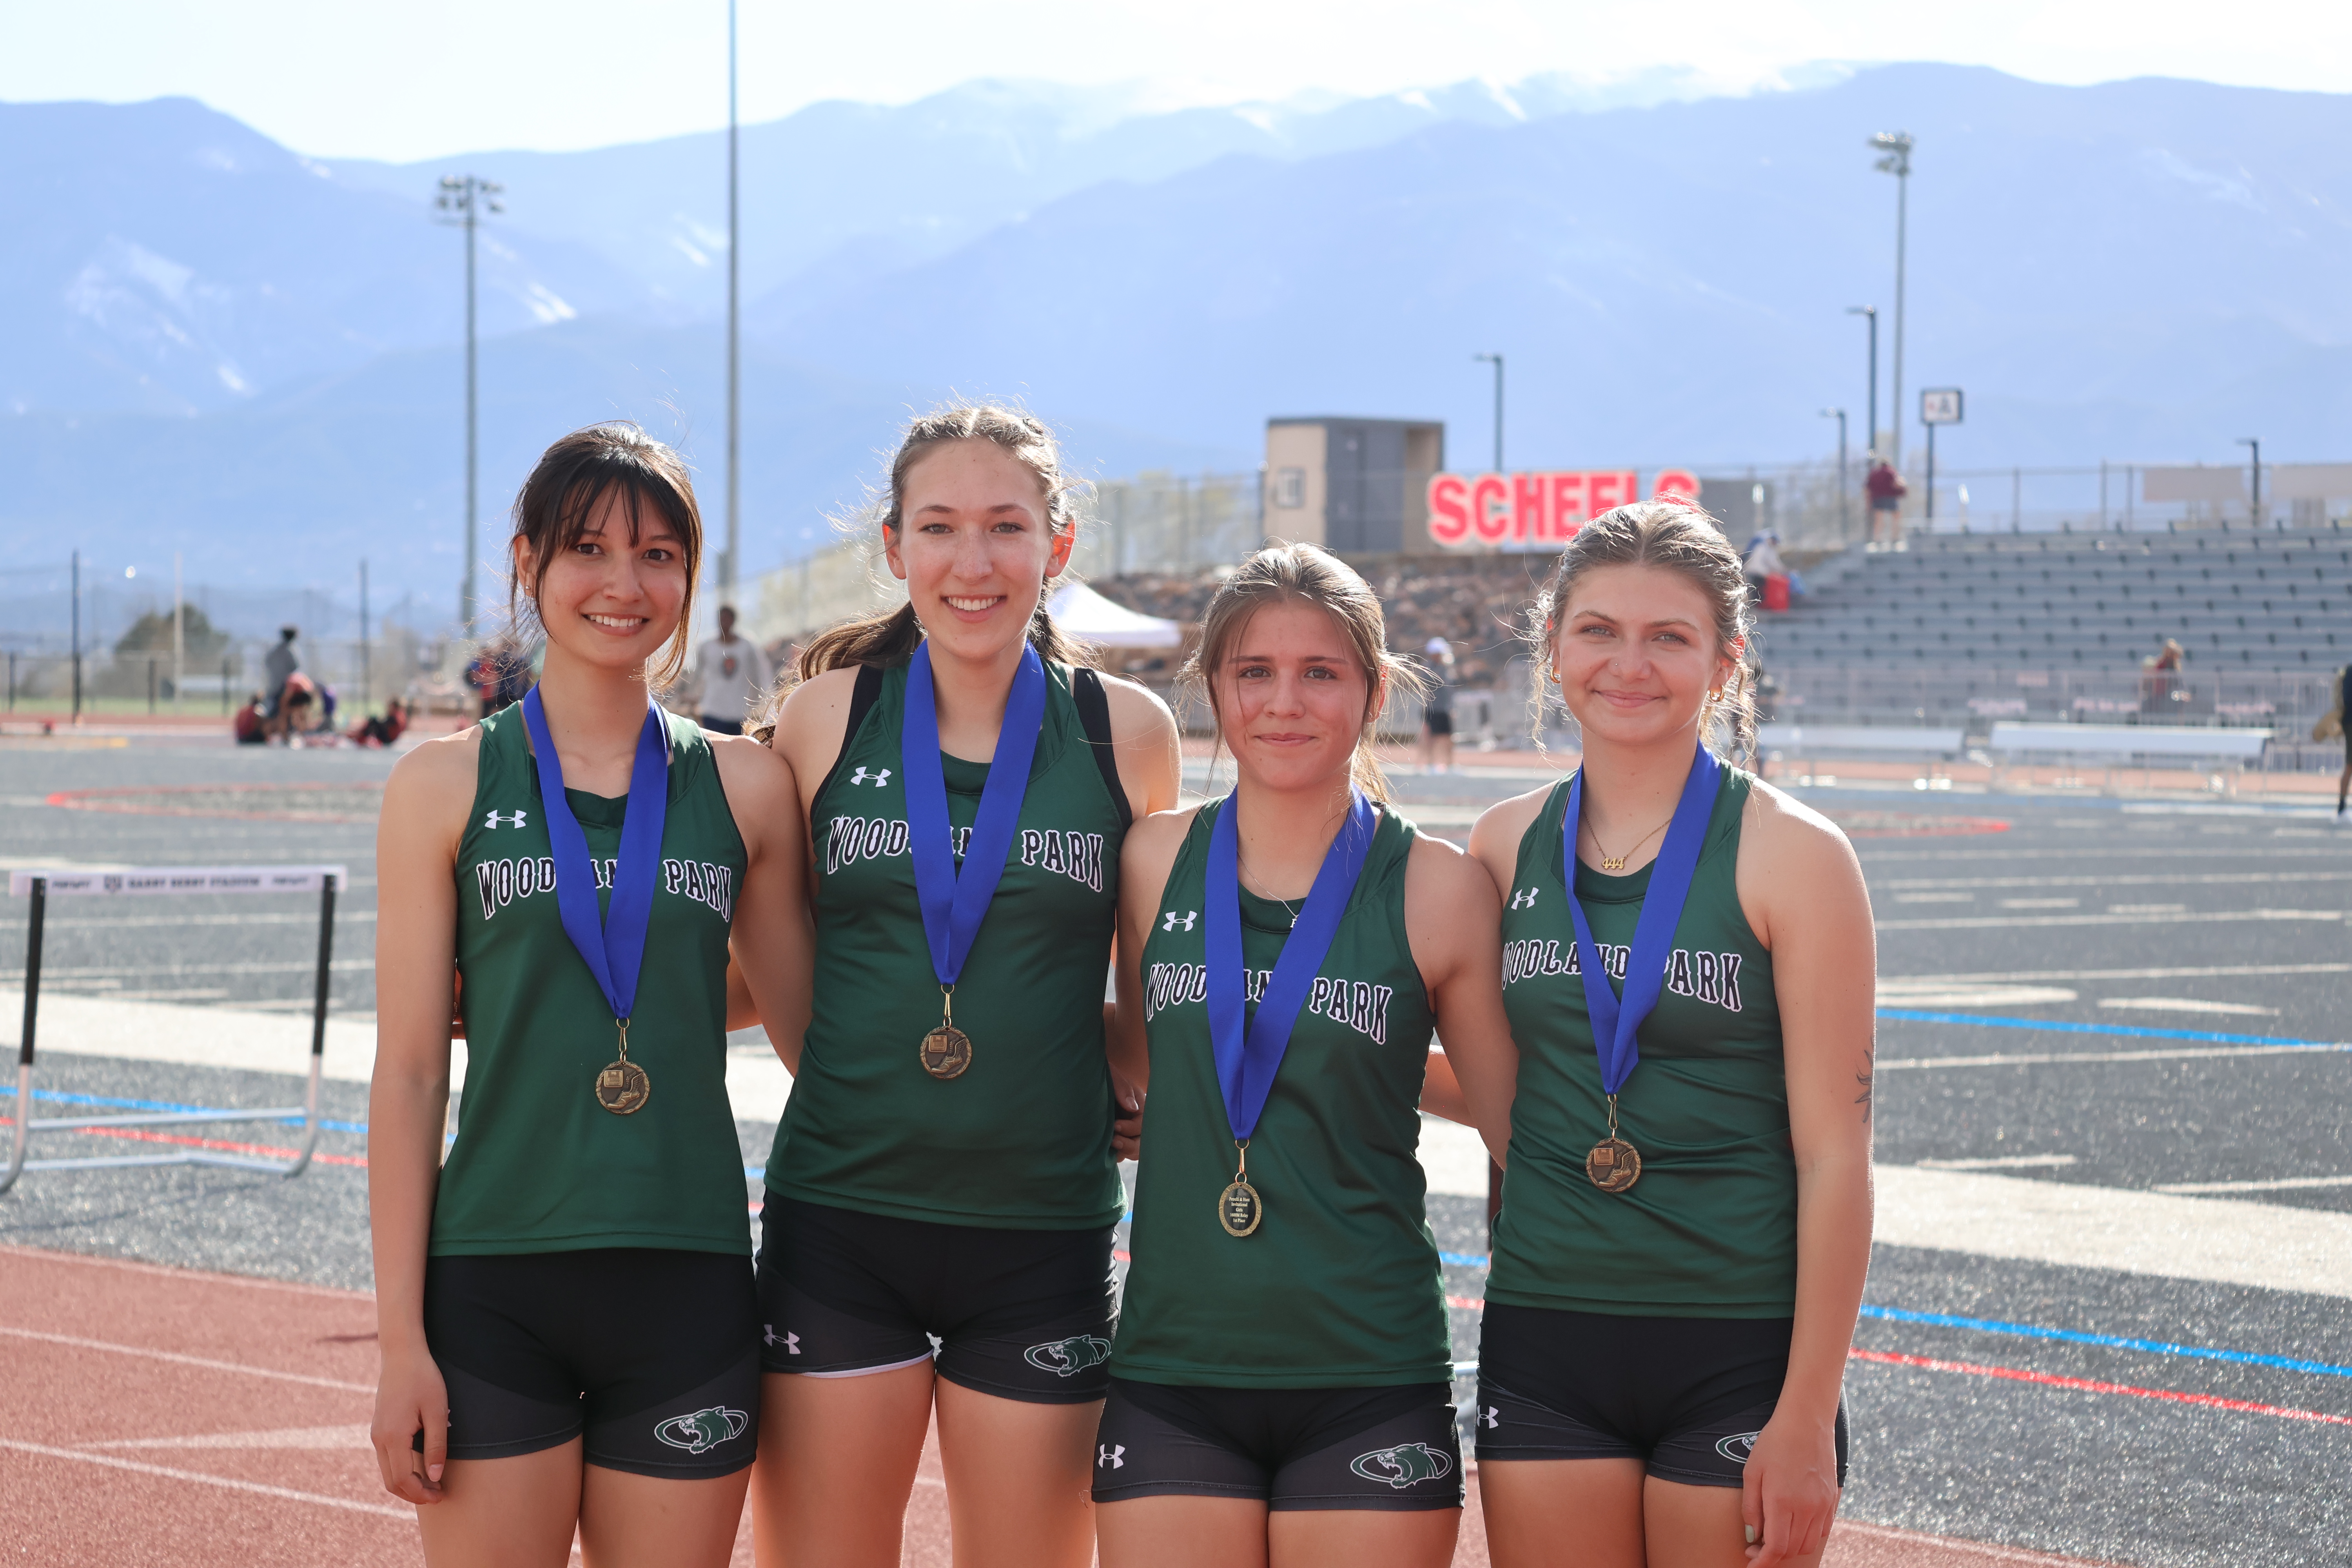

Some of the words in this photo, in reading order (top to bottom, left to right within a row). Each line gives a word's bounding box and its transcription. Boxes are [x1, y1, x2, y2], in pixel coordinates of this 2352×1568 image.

[663, 859, 731, 923] PARK
[1021, 829, 1103, 893] PARK
[1601, 857, 1624, 869] 444
[1309, 977, 1392, 1045] PARK
[1663, 949, 1742, 1012] ARK
